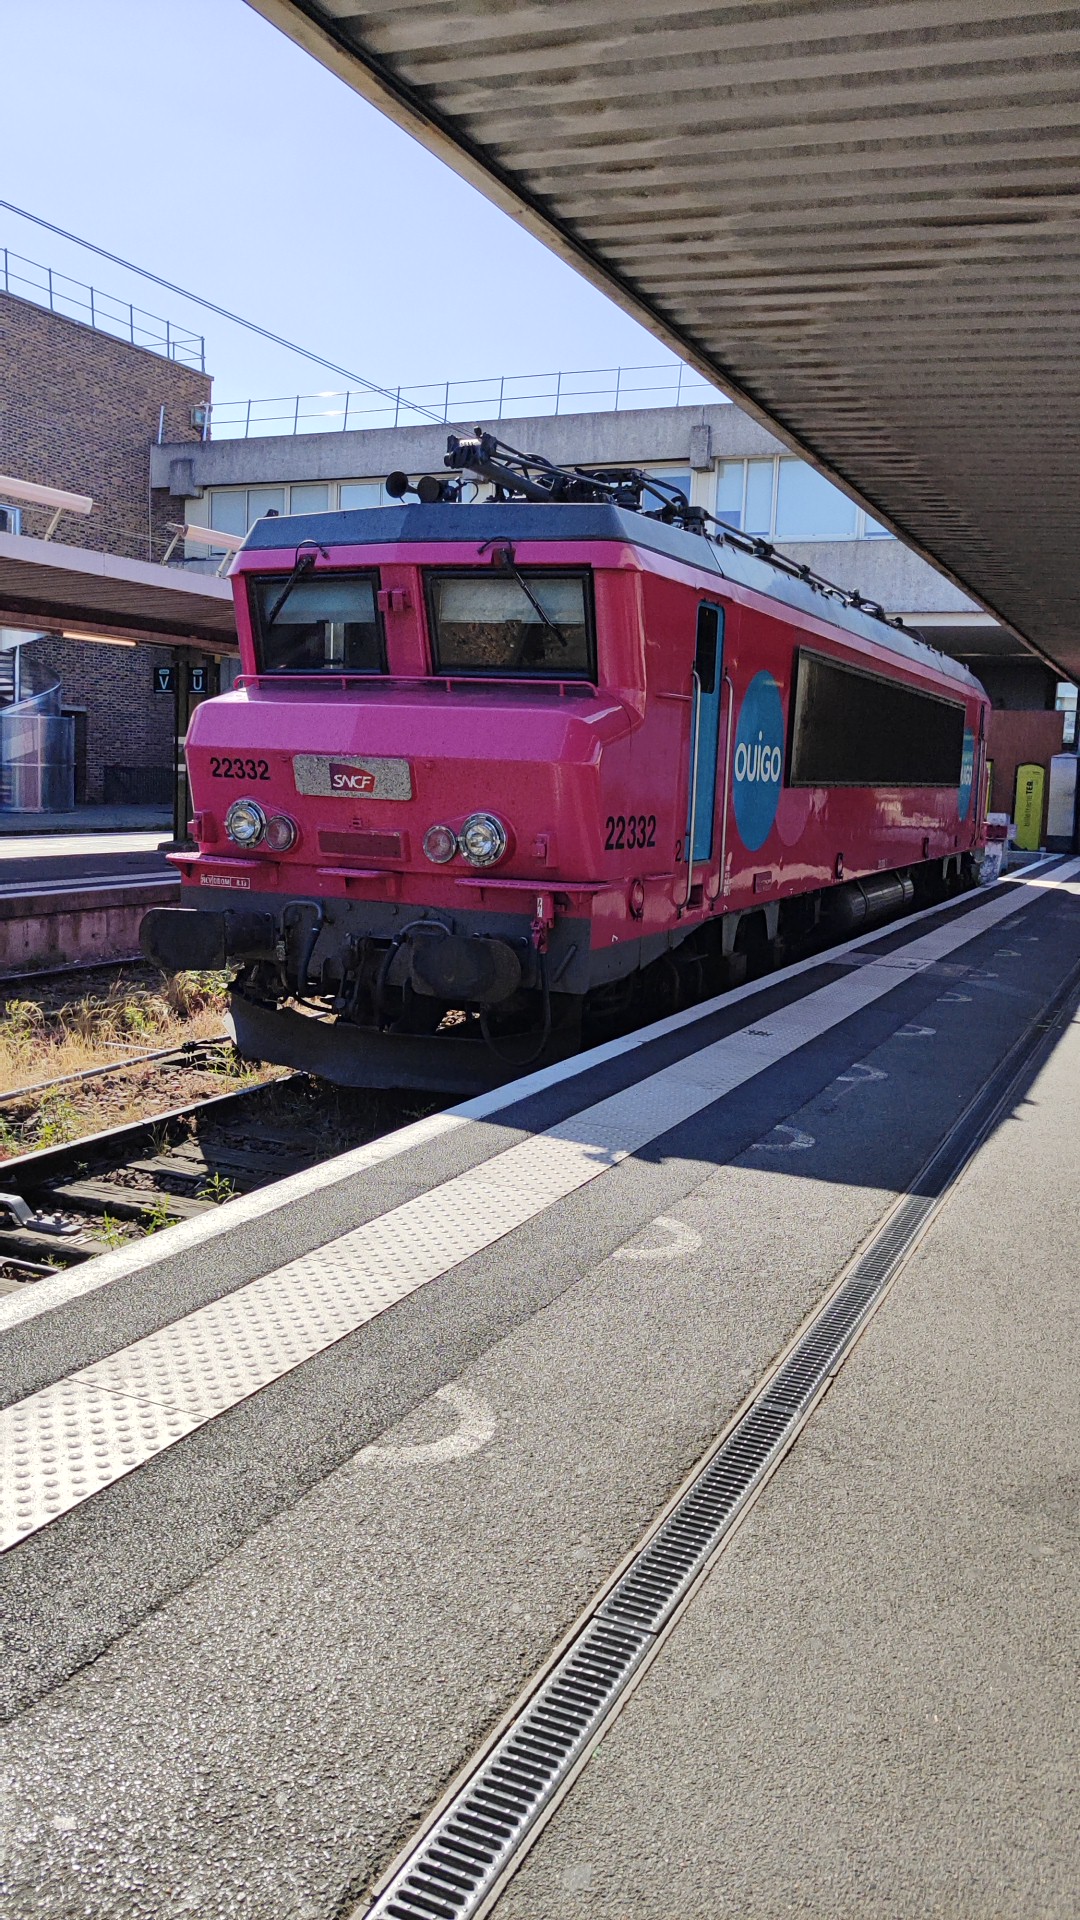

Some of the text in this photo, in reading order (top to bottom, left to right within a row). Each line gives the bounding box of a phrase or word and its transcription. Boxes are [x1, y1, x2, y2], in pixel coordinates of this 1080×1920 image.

[159, 675, 169, 689] V
[193, 675, 202, 690] U
[209, 757, 271, 780] 22332
[333, 774, 372, 789] SNCF
[604, 815, 656, 850] 22332
[675, 840, 682, 862] 2
